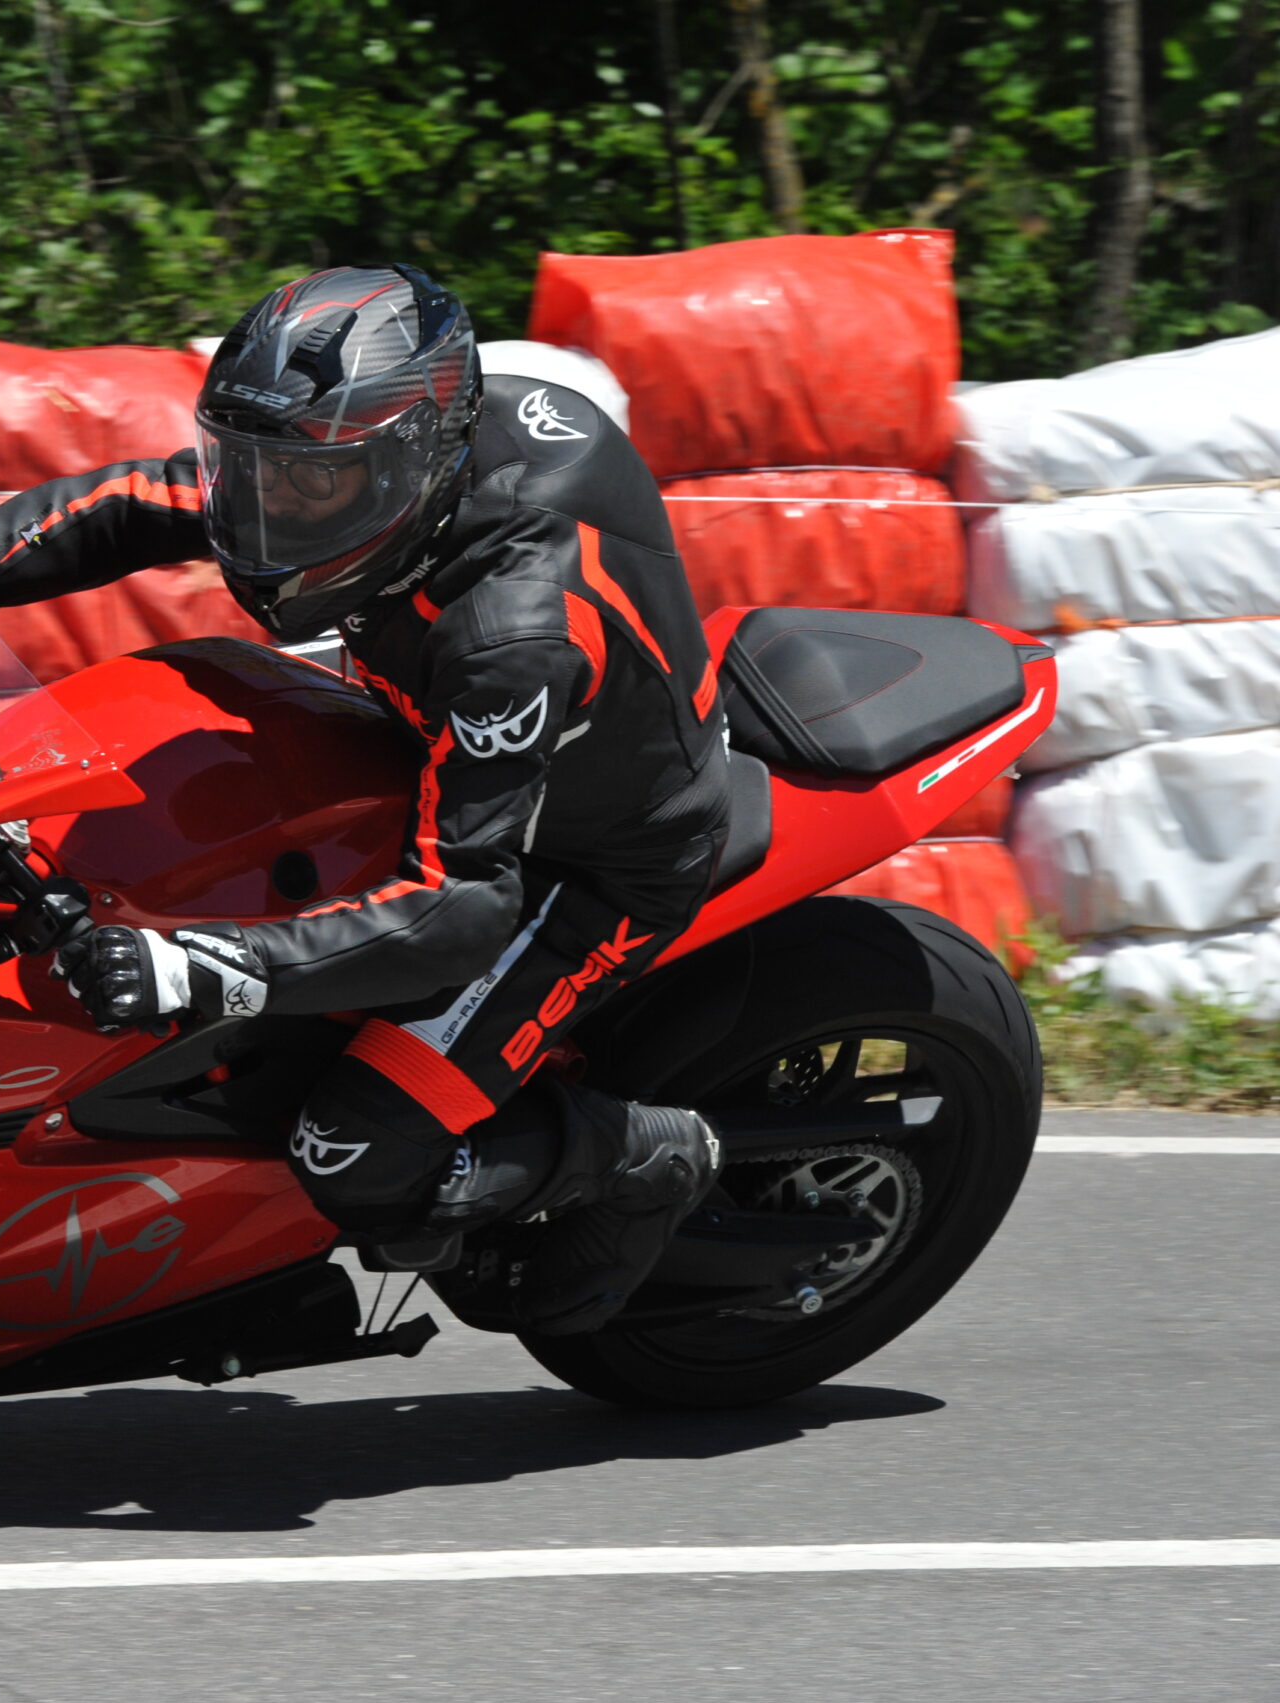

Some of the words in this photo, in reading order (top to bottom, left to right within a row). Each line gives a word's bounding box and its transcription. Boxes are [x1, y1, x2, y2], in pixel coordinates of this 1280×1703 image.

[214, 380, 293, 410] LS2
[377, 553, 439, 596] ERIK
[440, 971, 498, 1046] GP-RACE
[500, 916, 656, 1072] BERIK
